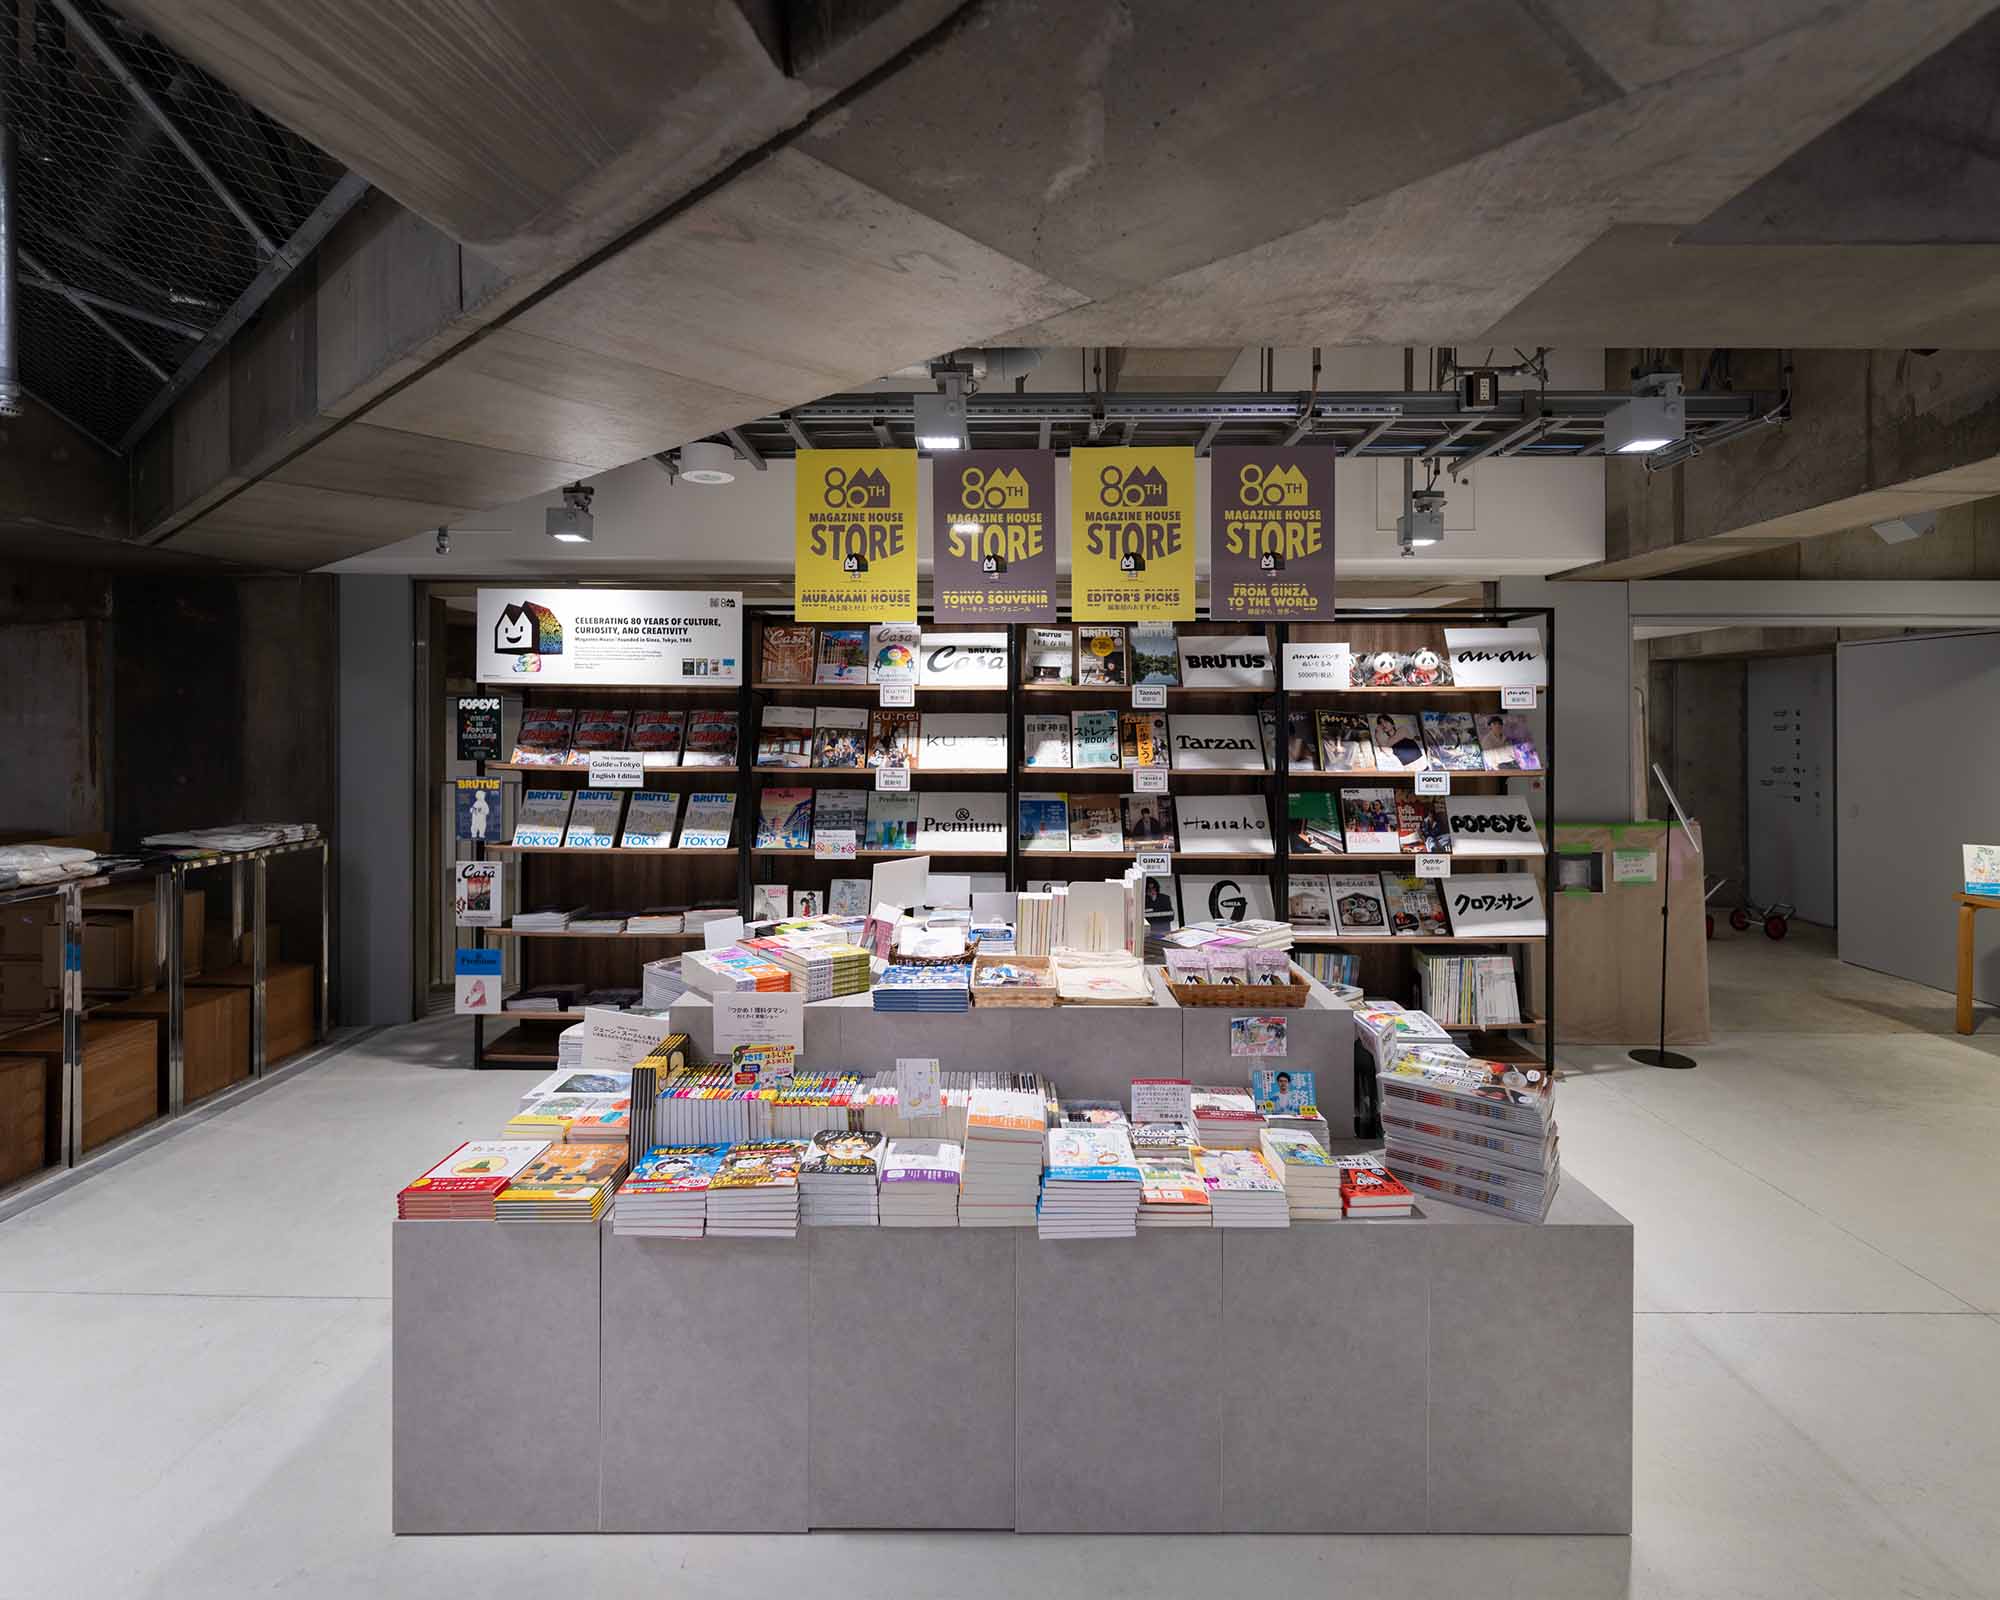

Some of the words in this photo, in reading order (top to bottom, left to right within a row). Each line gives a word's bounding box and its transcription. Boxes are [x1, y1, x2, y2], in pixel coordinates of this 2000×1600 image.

[809, 512, 864, 523] MAGAZINE
[868, 512, 904, 523] HOUSE
[947, 512, 1004, 523] MAGAZINE
[1007, 512, 1042, 523] HOUSE
[1085, 511, 1142, 521] MAGAZINE
[1145, 511, 1181, 521] HOUSE
[1224, 510, 1282, 521] MAGAZINE
[1285, 510, 1321, 520] HOUSE
[811, 523, 905, 561] STORE
[948, 524, 1044, 563] STORE
[1087, 522, 1182, 560] STORE
[1226, 521, 1322, 561] STORE
[1233, 587, 1267, 597] FROM
[1271, 586, 1309, 597] GINZA
[801, 592, 867, 603] MURAKAMI
[871, 592, 910, 603] HOUSE
[943, 593, 984, 605] TOKYO
[988, 593, 1048, 605] SOUVENIR
[1087, 592, 1140, 603] EDITOR'S
[1144, 592, 1180, 603] PICKS
[1228, 597, 1244, 607] TO
[1250, 597, 1271, 607] THE
[1274, 597, 1318, 607] WORLD
[575, 617, 629, 625] CELEBRATING
[630, 617, 642, 625] 80
[644, 617, 669, 625] YEARS
[671, 617, 682, 625] OF
[683, 618, 721, 627] CULTURE,
[575, 626, 620, 635] CURIOSITY,
[641, 627, 688, 635] CREATIVITY
[877, 628, 913, 643] Casa
[927, 645, 1005, 673] Casa
[1185, 654, 1265, 669] BRUTUS
[458, 698, 500, 711] POPEYE
[873, 711, 920, 721] ku:nel
[1074, 726, 1117, 736] ストレッチ
[1084, 736, 1109, 744] BOOK
[1175, 736, 1256, 750] Tarzan
[619, 761, 641, 769] Tokyo
[457, 779, 500, 789] BRUTUS
[923, 817, 1003, 832] Premium
[1183, 816, 1266, 830] Hanako
[1450, 814, 1533, 833] POPEYE
[516, 836, 558, 846] TOKYO
[568, 836, 611, 847] TOKYO
[684, 837, 726, 846] TOKYO
[462, 863, 496, 879] Casa
[1455, 893, 1534, 915] クロワッサン
